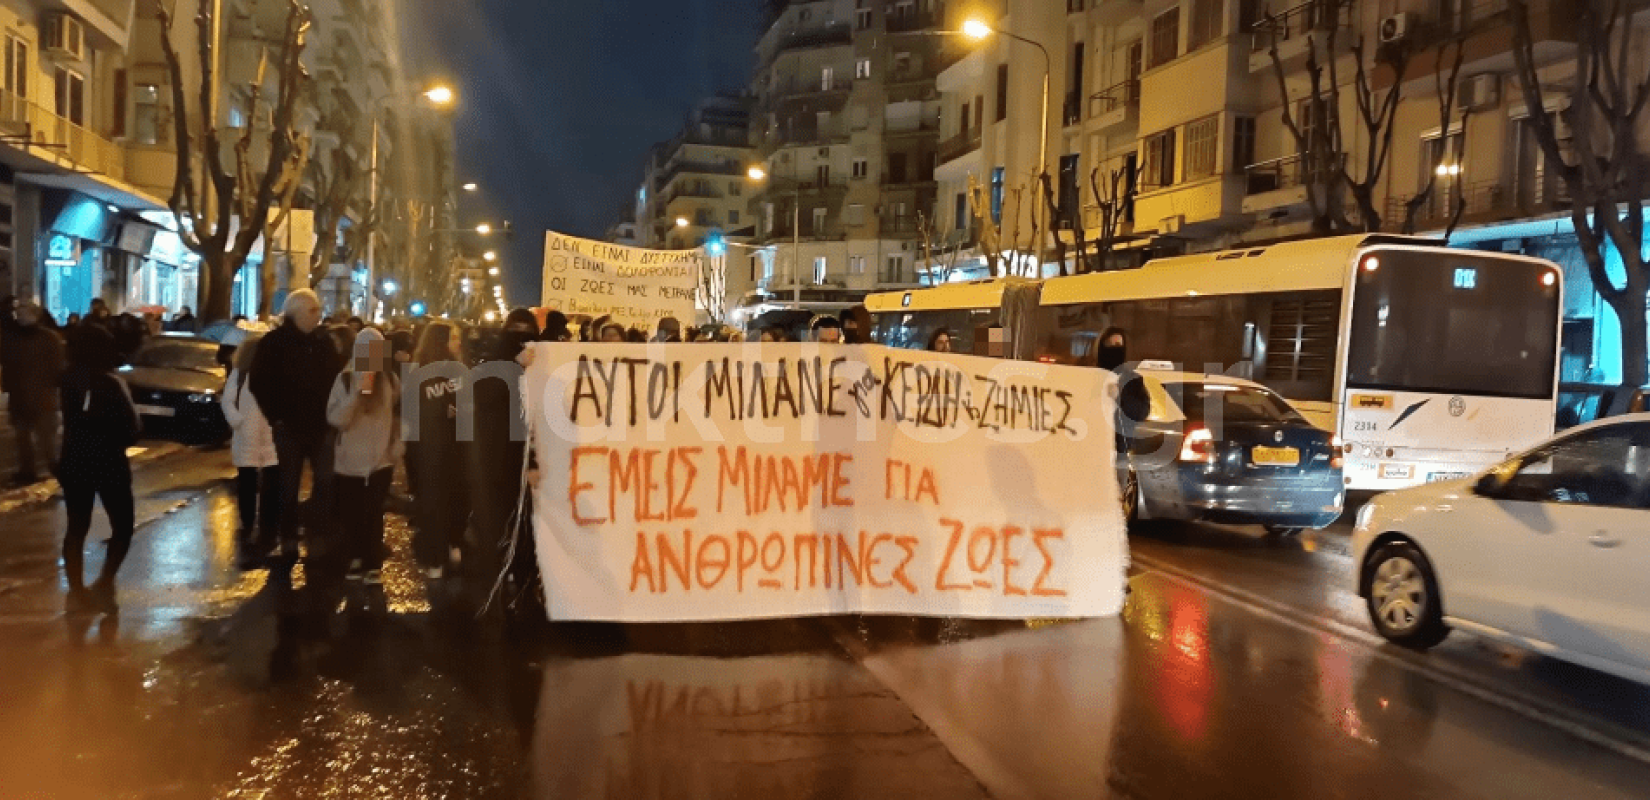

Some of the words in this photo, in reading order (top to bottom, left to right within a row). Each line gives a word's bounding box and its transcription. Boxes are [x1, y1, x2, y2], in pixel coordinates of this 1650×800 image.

[551, 237, 580, 253] ΔΕΝ
[592, 245, 630, 262] ΕΙΝΑΙ
[640, 251, 698, 265] ΔΥΣΤΥΧΗΜ
[573, 257, 605, 273] ΕΙΝΑΙ
[551, 277, 566, 291] ΟΙ
[580, 279, 615, 295] ΖΩΕΣ
[627, 285, 648, 298] ΜΑΣ
[569, 354, 682, 427] ΑΥΤΟΙ
[704, 355, 847, 421] ΜΙΛΑΝΕ
[881, 356, 962, 428] ΚΕΡΔΗ
[974, 375, 1077, 436] ΖΗΜΙΕΣ
[569, 445, 703, 527] ΕΜΕΙΣ
[715, 444, 854, 516] ΜΙΛΑΜΕ
[885, 458, 940, 506] ΓΙΑ
[629, 528, 918, 594] ΑΝΘΡΩΠΙΝΕΣ
[934, 517, 1067, 597] ΖΩΕΣ
